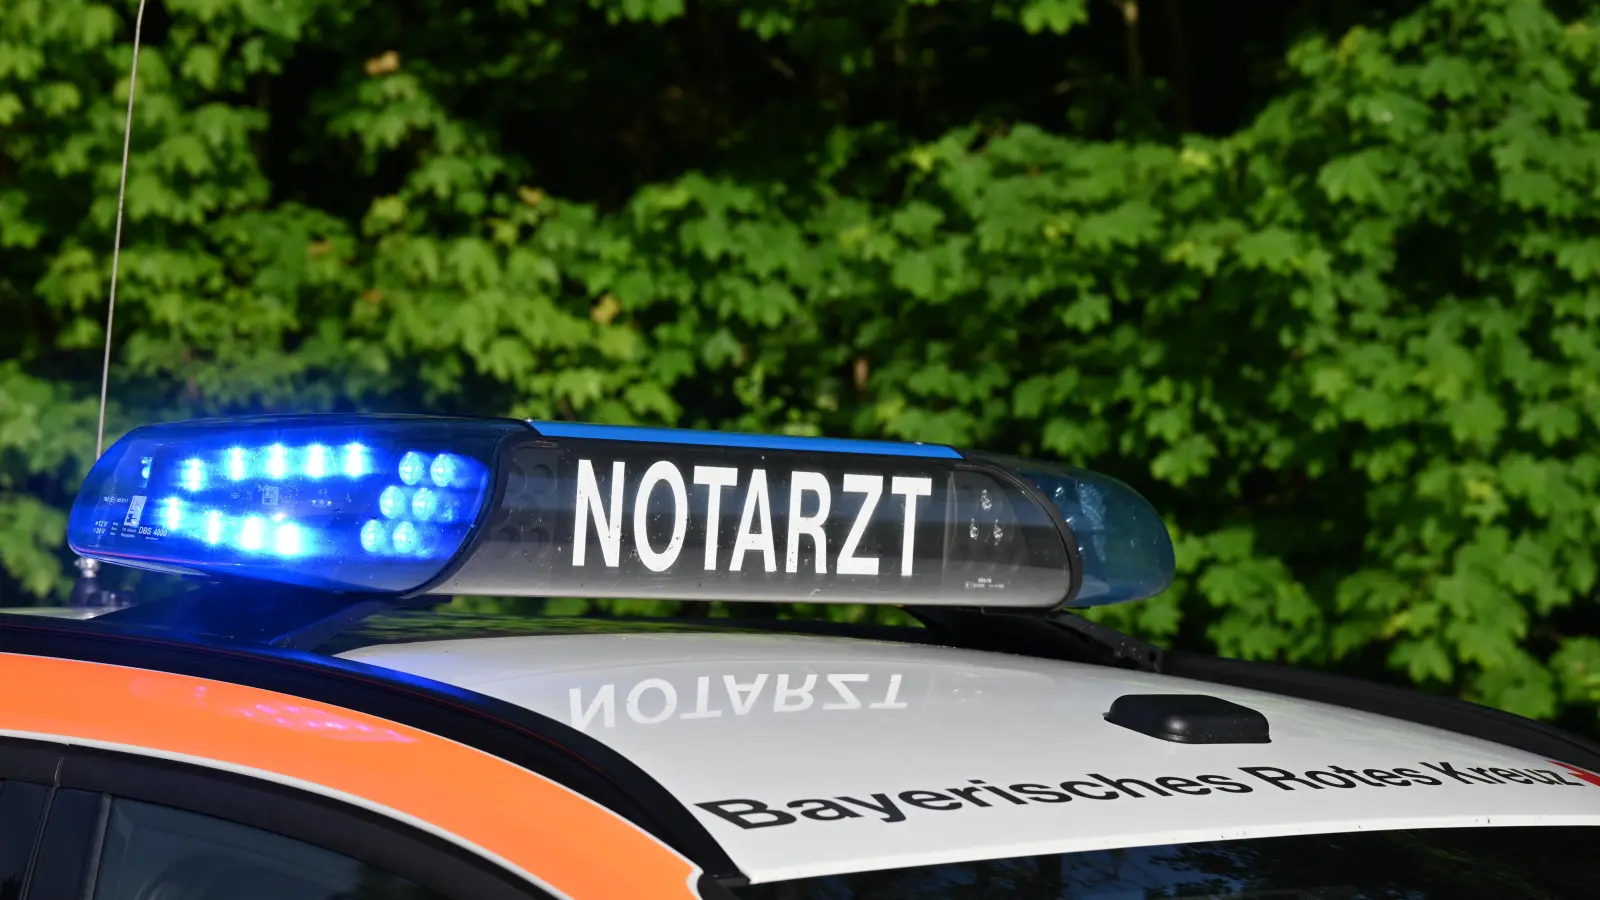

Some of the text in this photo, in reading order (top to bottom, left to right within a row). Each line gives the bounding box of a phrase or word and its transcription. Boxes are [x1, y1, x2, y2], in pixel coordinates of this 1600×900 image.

[138, 526, 152, 535] DBS
[153, 528, 168, 537] 4000
[572, 459, 932, 577] NOTARZT
[694, 761, 1586, 830] Bayerisches Rotes Kreuz
